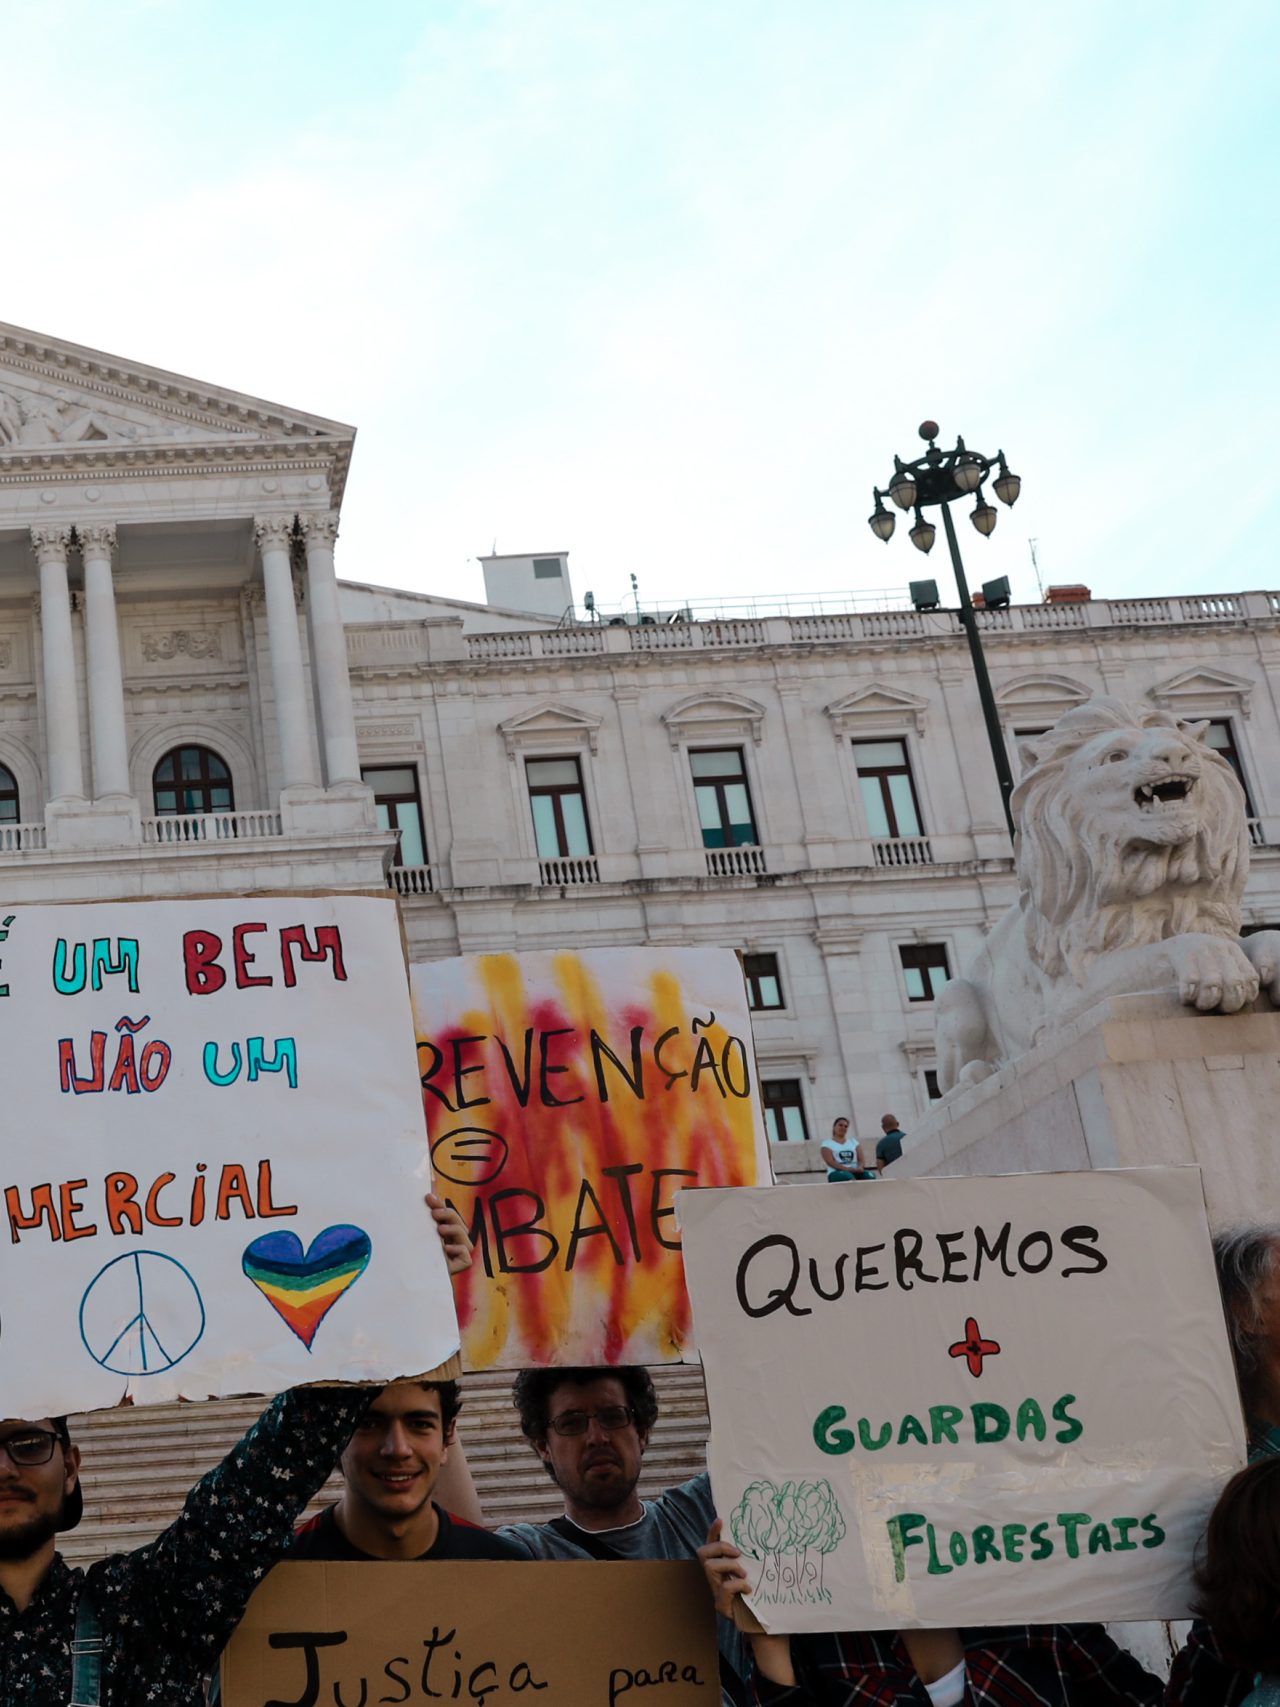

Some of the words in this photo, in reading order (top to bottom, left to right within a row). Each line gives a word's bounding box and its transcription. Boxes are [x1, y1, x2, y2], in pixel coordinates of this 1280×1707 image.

[51, 936, 141, 996] UM
[183, 922, 348, 996] BEM
[58, 1015, 172, 1095] NÃO
[202, 1036, 299, 1089] UM
[416, 1011, 751, 1113] REVENÇÃO
[445, 1163, 699, 1279] MBATE
[735, 1221, 1108, 1319] QUEREMOS
[812, 1393, 1084, 1456] GUARDAS
[886, 1512, 1167, 1584] FLORESTAIS
[263, 1625, 549, 1707] Justiça
